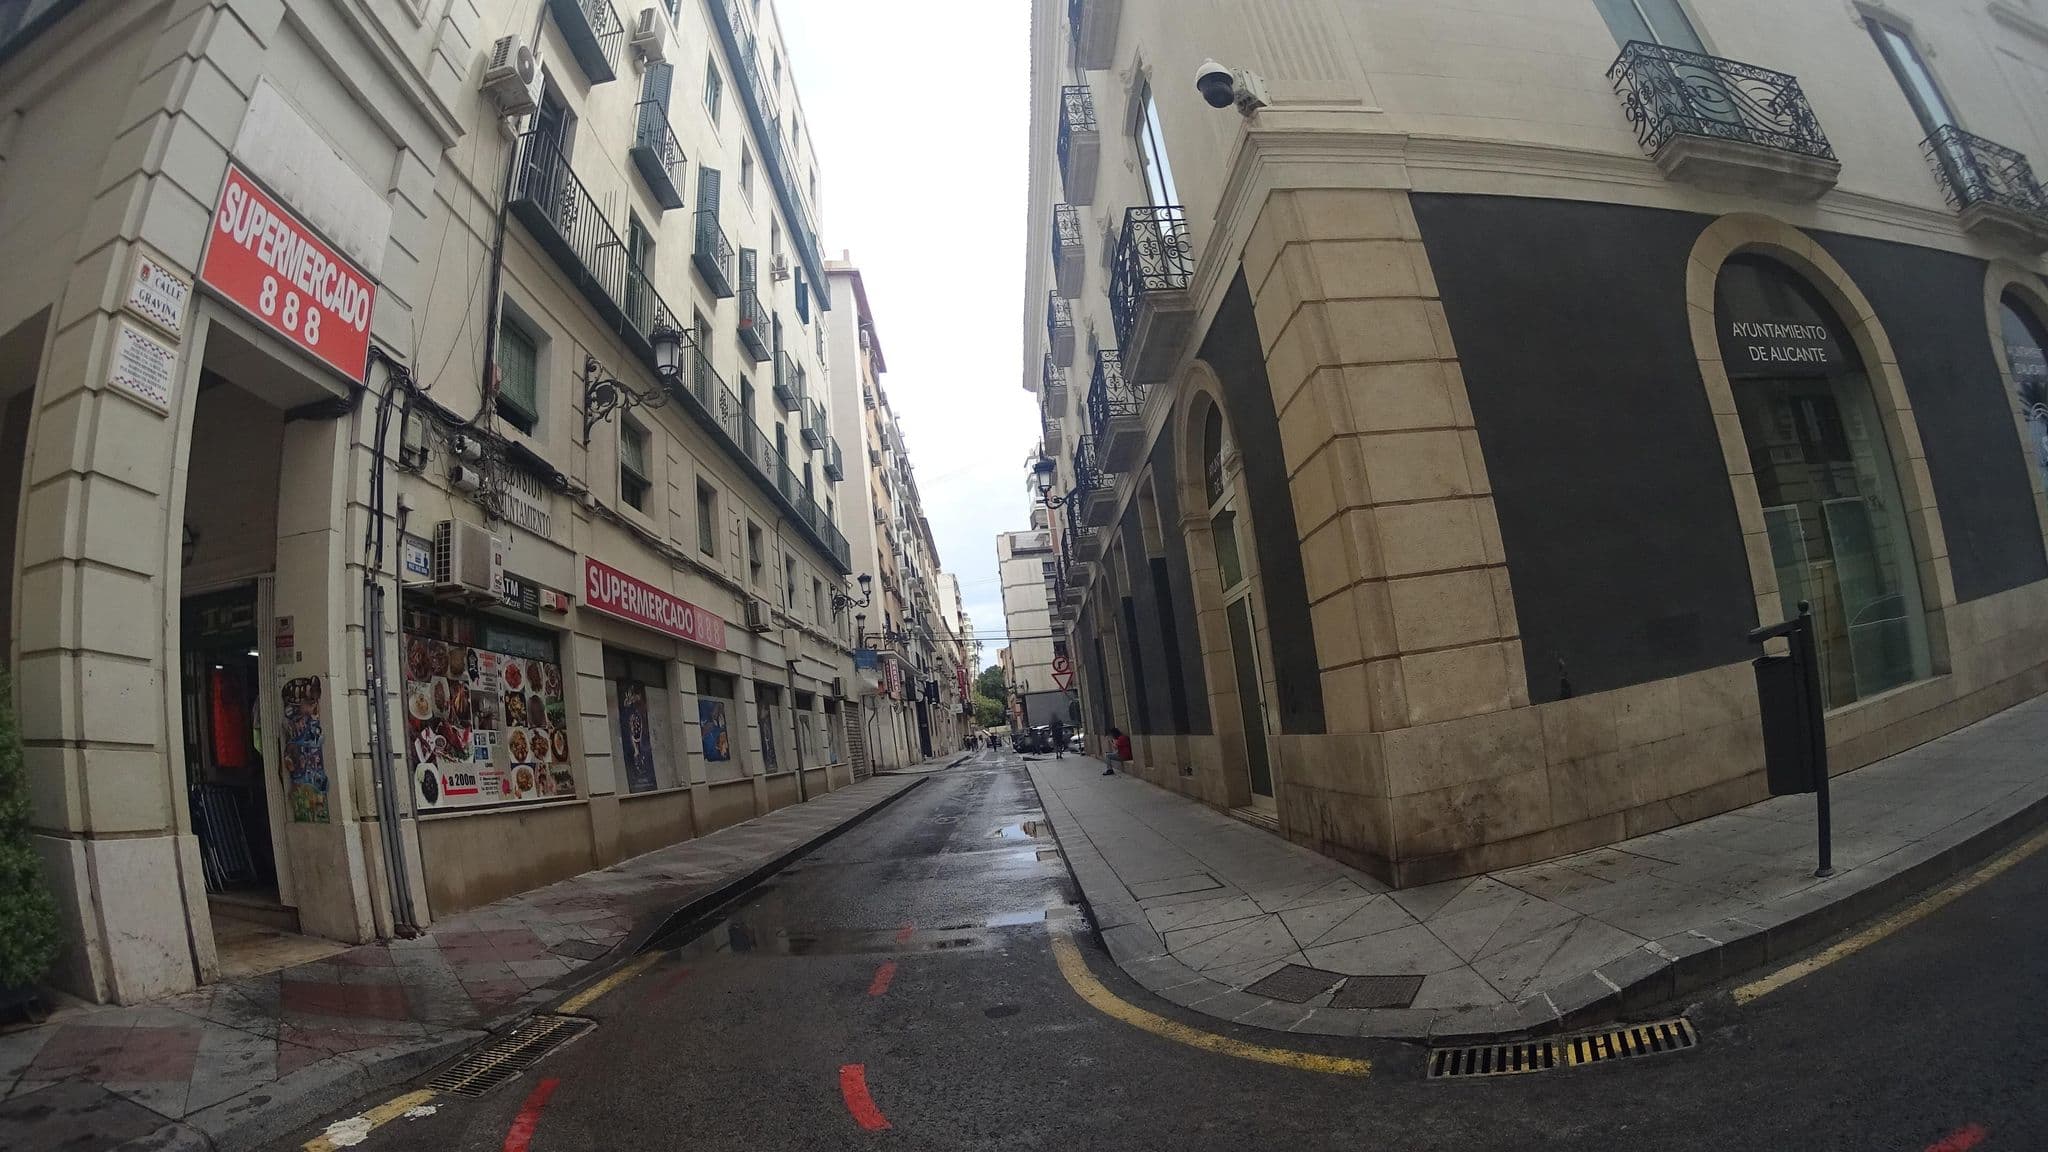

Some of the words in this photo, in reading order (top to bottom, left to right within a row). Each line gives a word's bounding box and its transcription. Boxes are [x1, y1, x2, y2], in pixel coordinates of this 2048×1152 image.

[219, 181, 370, 333] SUPERMERCADO
[155, 277, 183, 301] CALLE
[139, 288, 178, 321] GRAVINA
[1732, 321, 1827, 341] AYUNTAMIENTO
[1748, 346, 1769, 361] DE
[1770, 347, 1828, 362] ALICANTE
[589, 565, 694, 635] SUPERMERCADO
[455, 773, 476, 786] 200m
